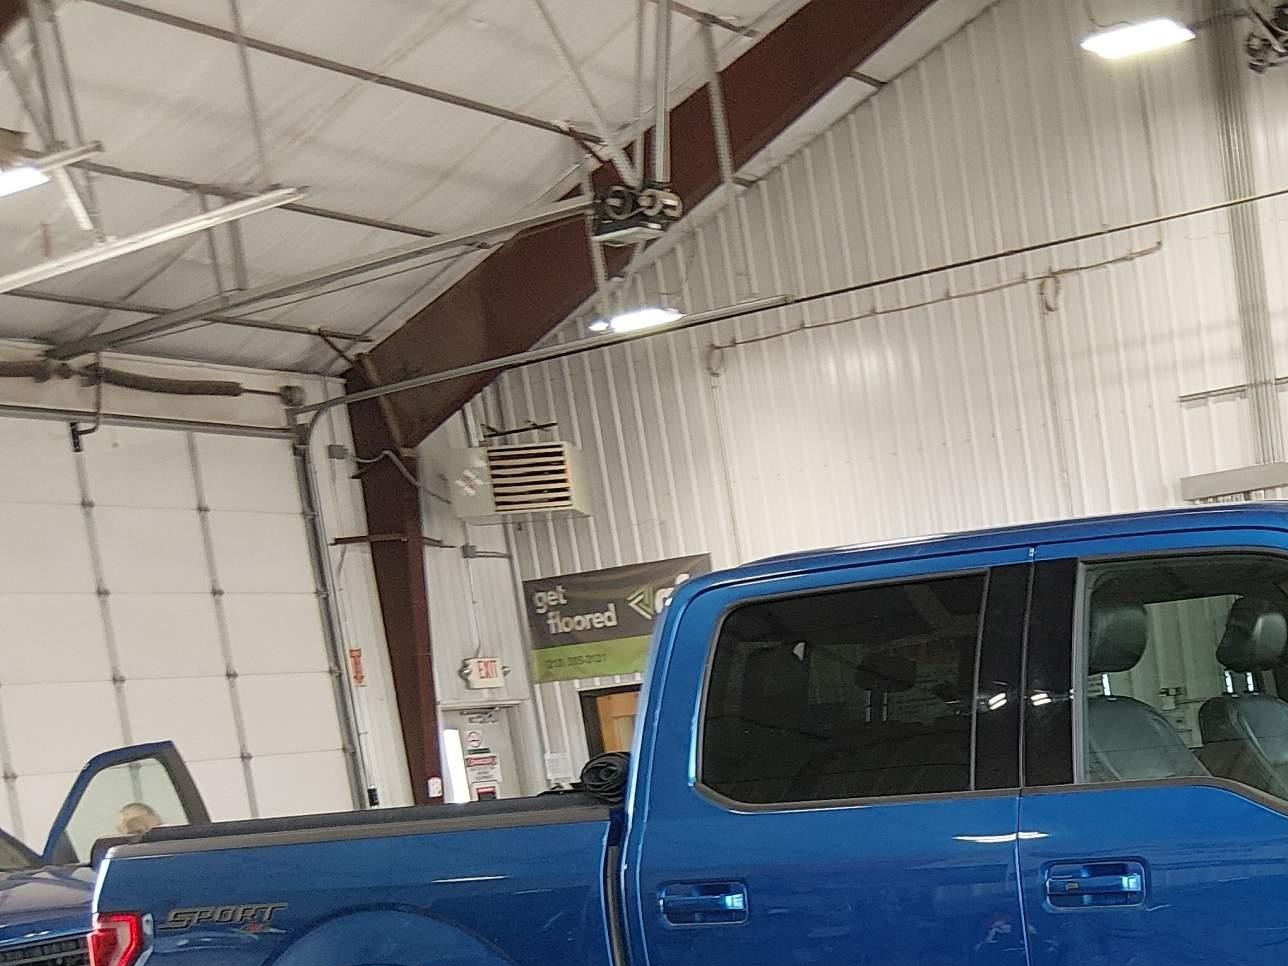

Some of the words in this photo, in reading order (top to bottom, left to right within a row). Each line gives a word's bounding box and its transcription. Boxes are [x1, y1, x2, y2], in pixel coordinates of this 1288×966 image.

[533, 585, 567, 614] get
[547, 603, 618, 634] floored
[477, 660, 499, 680] EXIT
[158, 902, 288, 931] SPORT
